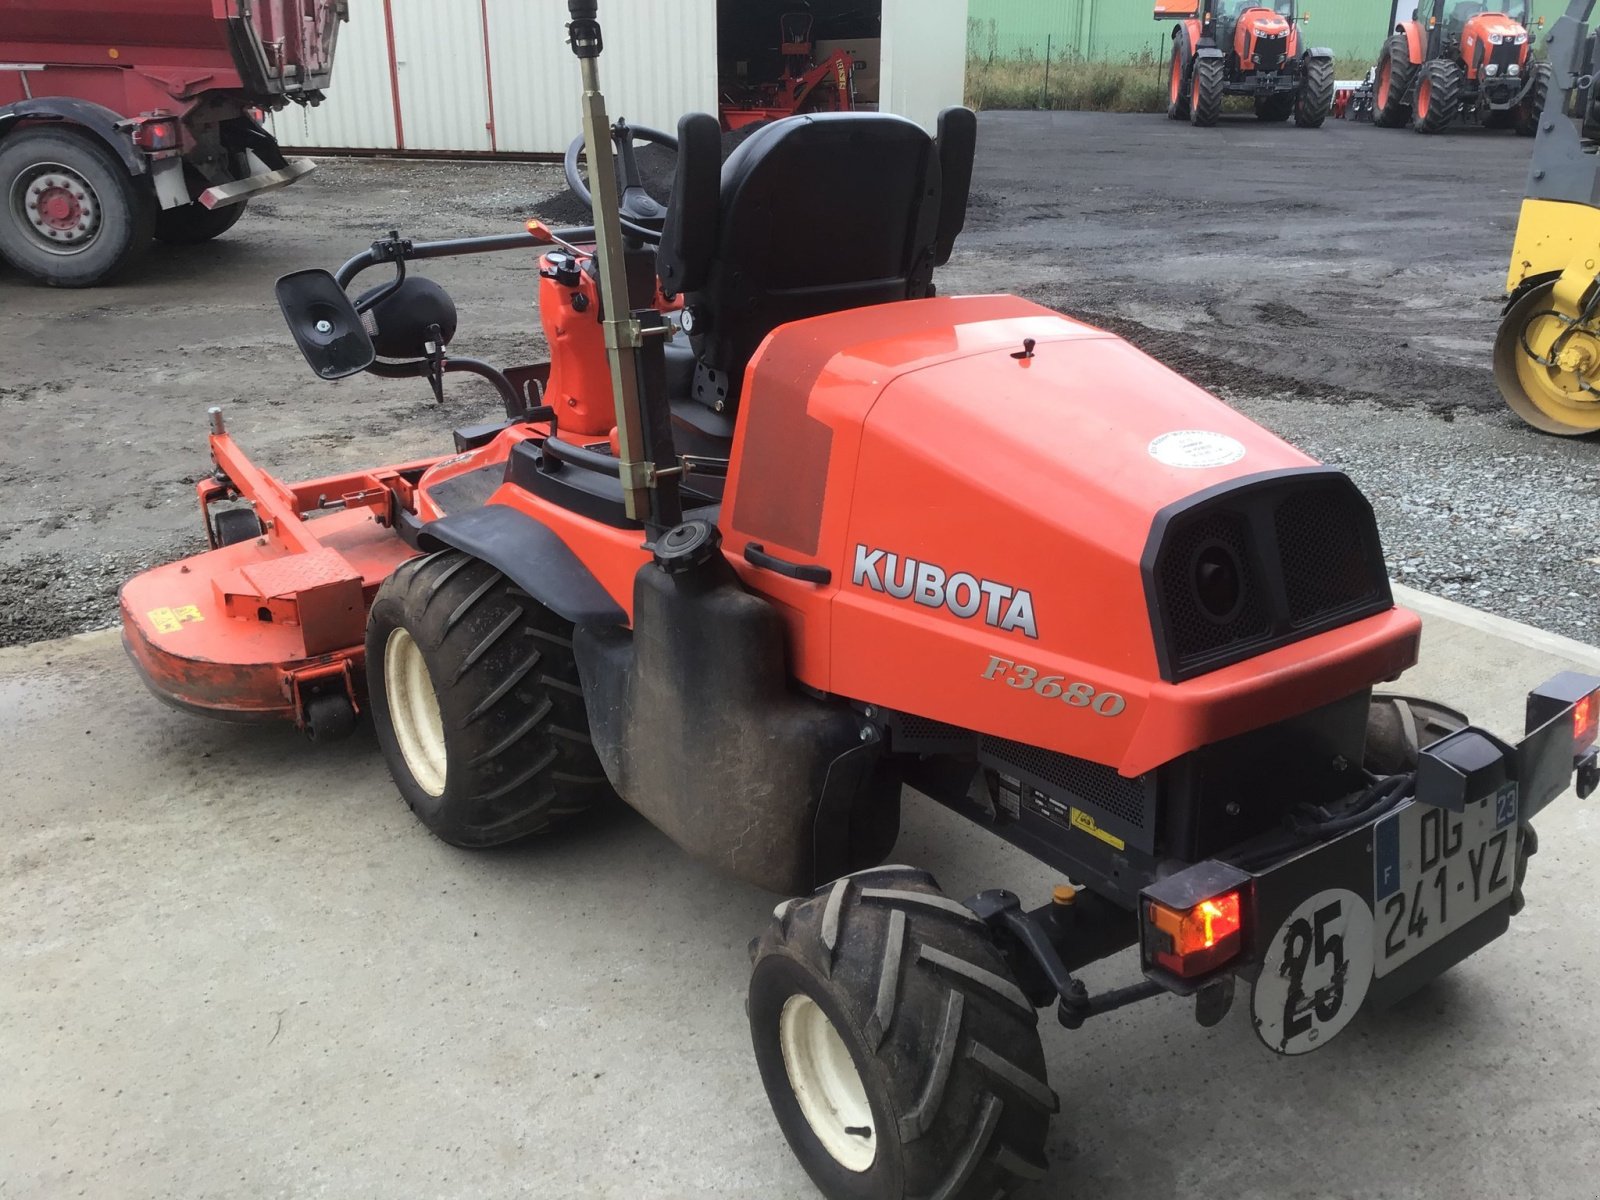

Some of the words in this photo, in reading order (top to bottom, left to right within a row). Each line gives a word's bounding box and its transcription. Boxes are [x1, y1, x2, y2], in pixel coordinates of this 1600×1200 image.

[852, 543, 1039, 639] KUBOTA
[980, 655, 1127, 717] F3680
[1497, 789, 1516, 825] 23
[1383, 865, 1393, 886] F
[1384, 829, 1508, 960] 241-YZ
[1282, 899, 1346, 1040] 25
